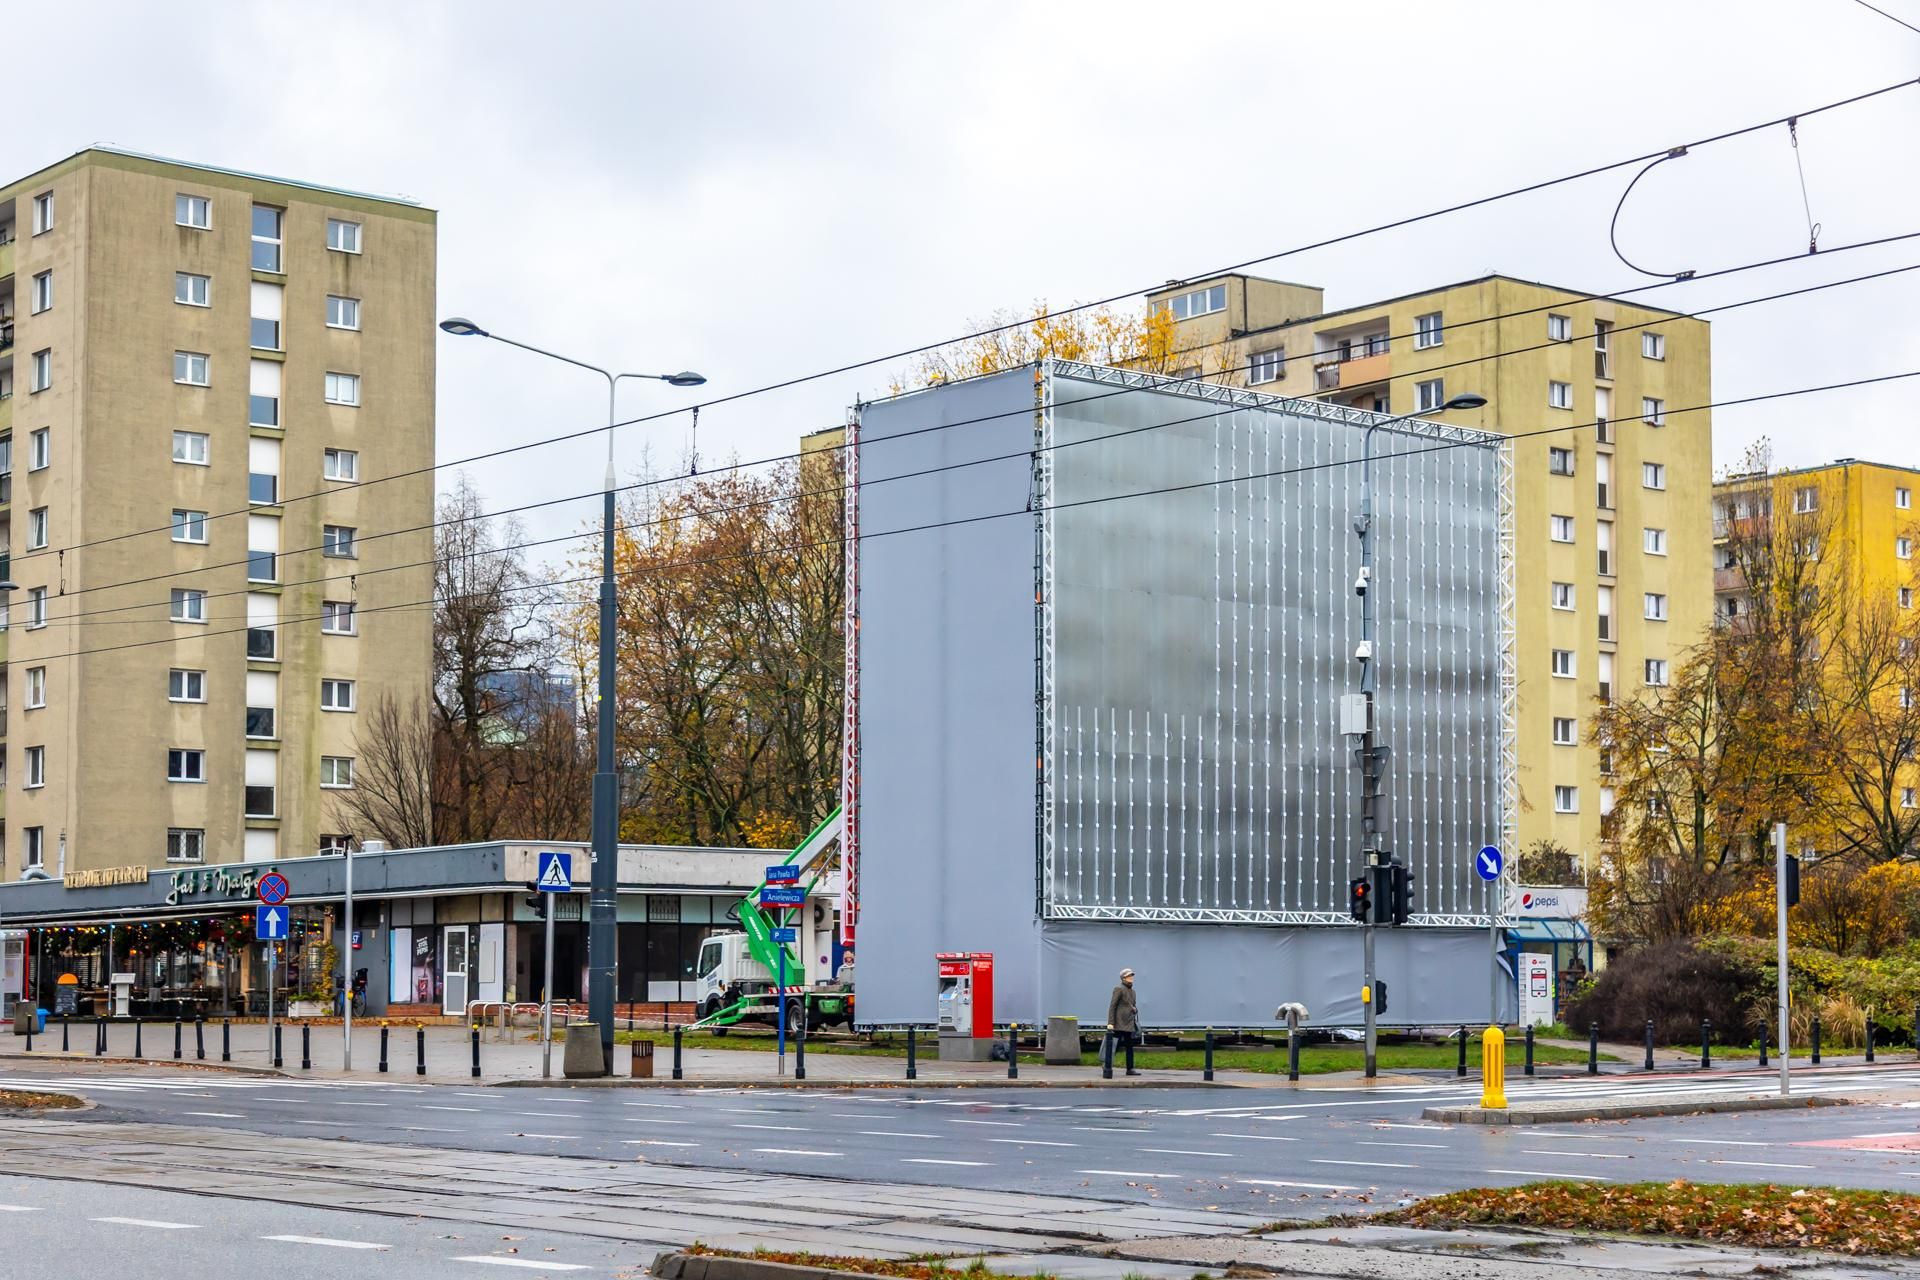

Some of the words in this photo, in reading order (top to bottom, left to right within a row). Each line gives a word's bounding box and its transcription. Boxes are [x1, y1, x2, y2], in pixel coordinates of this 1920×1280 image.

[213, 866, 260, 898] Małgo
[767, 893, 800, 902] Anielewicza
[1535, 896, 1559, 908] pepsi
